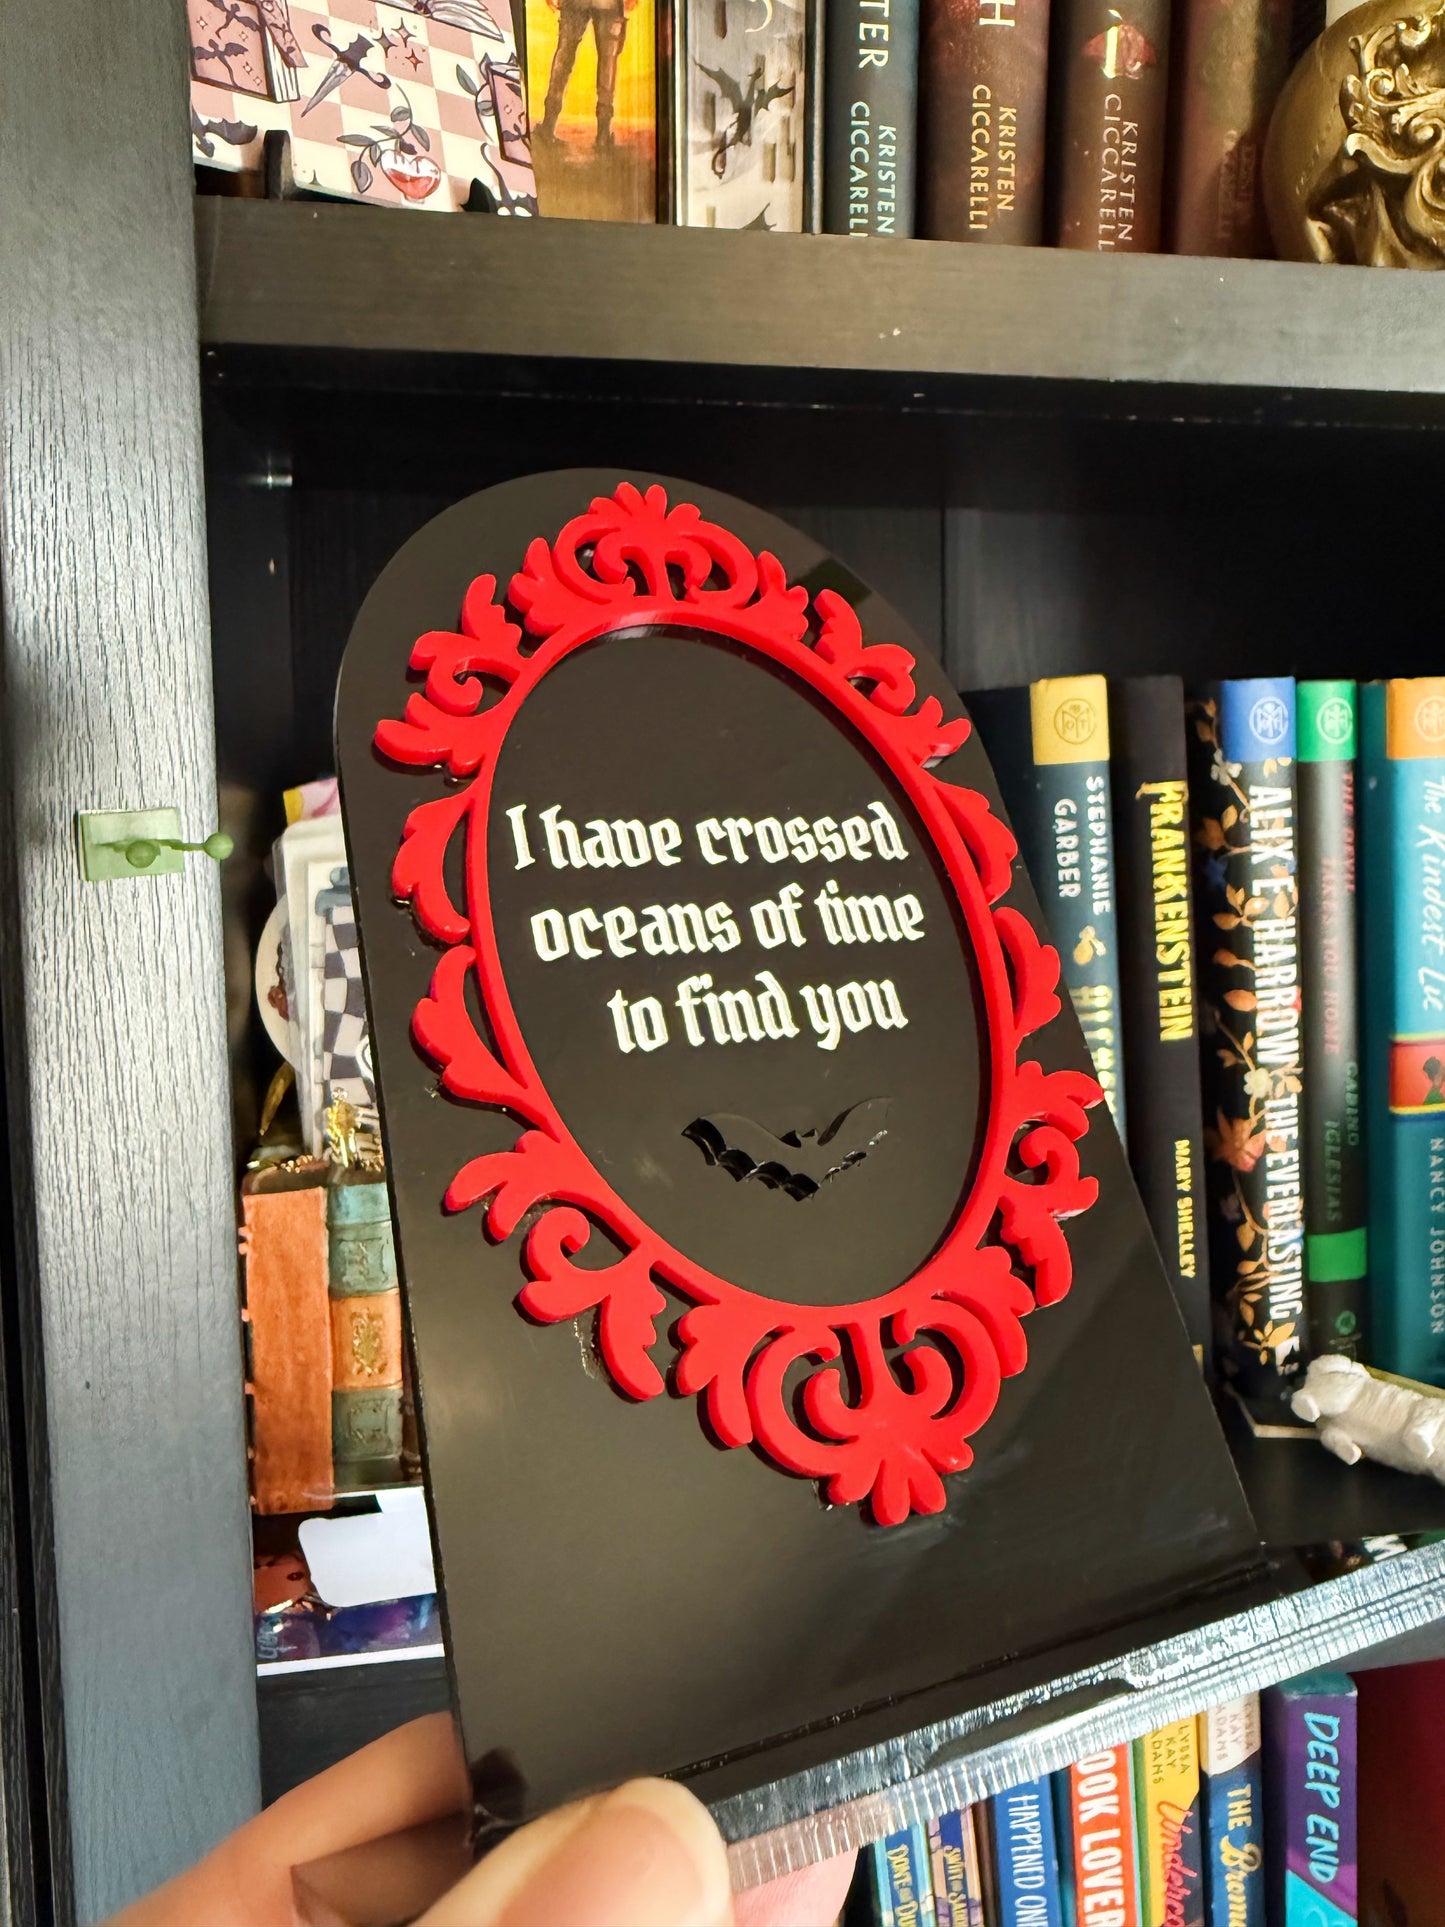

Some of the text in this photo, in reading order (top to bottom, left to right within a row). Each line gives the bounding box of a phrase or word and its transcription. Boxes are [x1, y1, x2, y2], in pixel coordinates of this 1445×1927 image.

[876, 124, 897, 234] KRISTEN
[969, 84, 991, 230] CICCARELLI
[996, 106, 1017, 211] KRISTEN
[1117, 120, 1138, 241] KRISTEN
[505, 800, 909, 871] I have crossed
[1054, 798, 1082, 898] GARBER
[1086, 775, 1111, 916] STEPHANIE
[1249, 784, 1296, 865] ALIX
[530, 879, 926, 962] oceans of time
[1135, 780, 1193, 1042] FRANKENSTEIN
[607, 970, 909, 1053] to find you
[1253, 915, 1300, 1064] HARROW
[1323, 990, 1340, 1055] HOME
[1174, 1139, 1196, 1279] MARY SHELLEY
[1264, 1092, 1303, 1320] THE EVERLASTING
[1324, 1120, 1343, 1222] IGLESIAS
[1429, 1136, 1445, 1335] NANCY JOHNSON
[1077, 1750, 1119, 1824] OOK
[1166, 1736, 1177, 1769] KAY
[1304, 1711, 1341, 1809] DEEP
[1008, 1793, 1046, 1890] HAPPENED
[1226, 1783, 1252, 1832] THE
[1305, 1813, 1340, 1884] END
